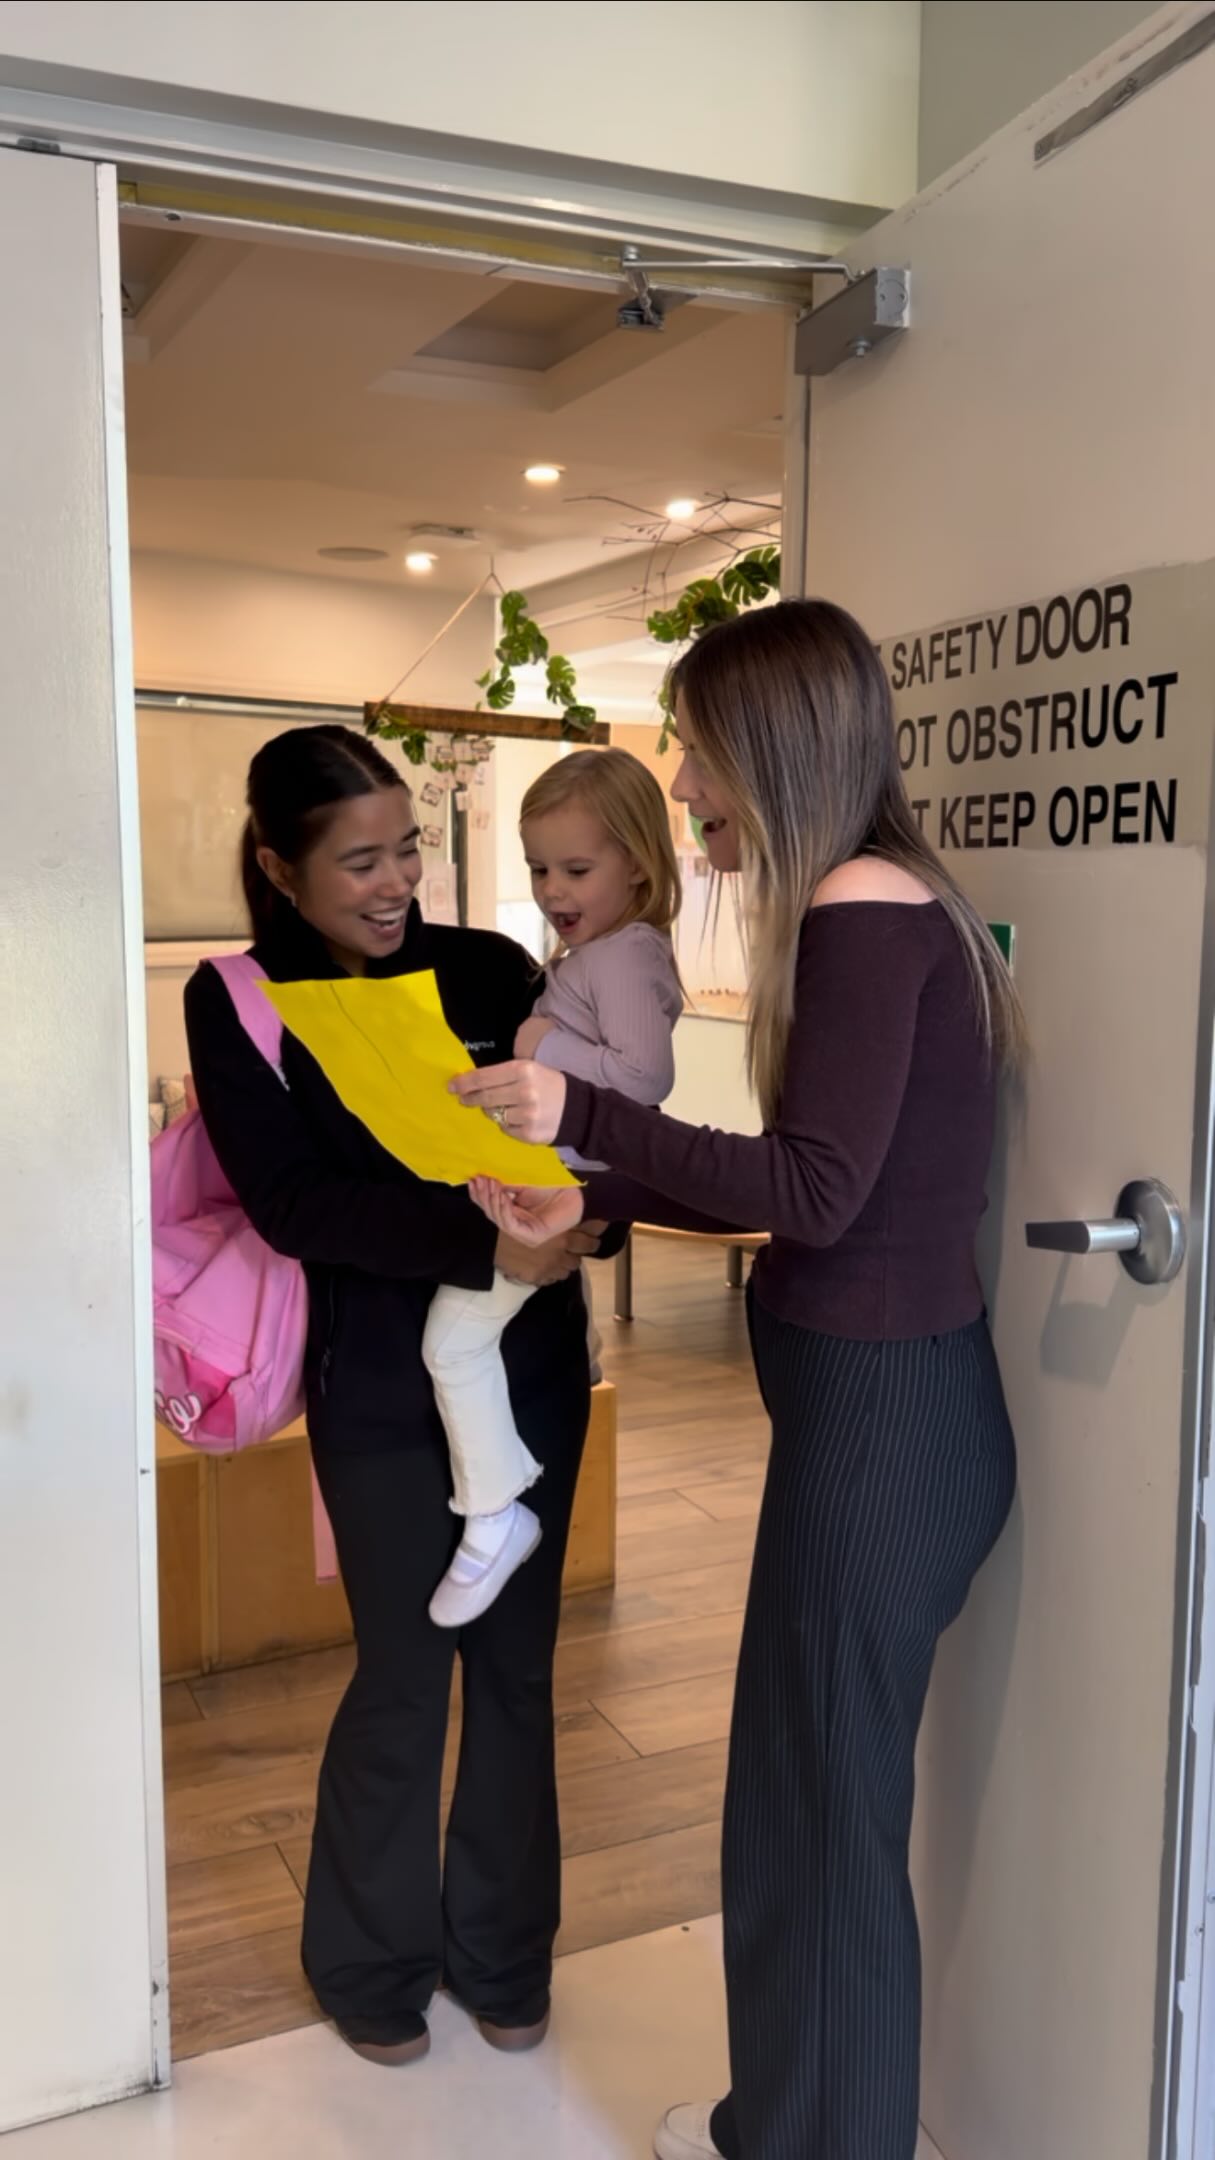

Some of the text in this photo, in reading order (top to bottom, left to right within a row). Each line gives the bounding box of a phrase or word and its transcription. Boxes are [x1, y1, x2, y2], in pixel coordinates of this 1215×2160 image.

[891, 583, 1132, 691] SAFETY DOOR
[896, 671, 1179, 771] OT OBSTRUCT
[939, 791, 1036, 849] KEEP
[1048, 778, 1177, 847] OPEN
